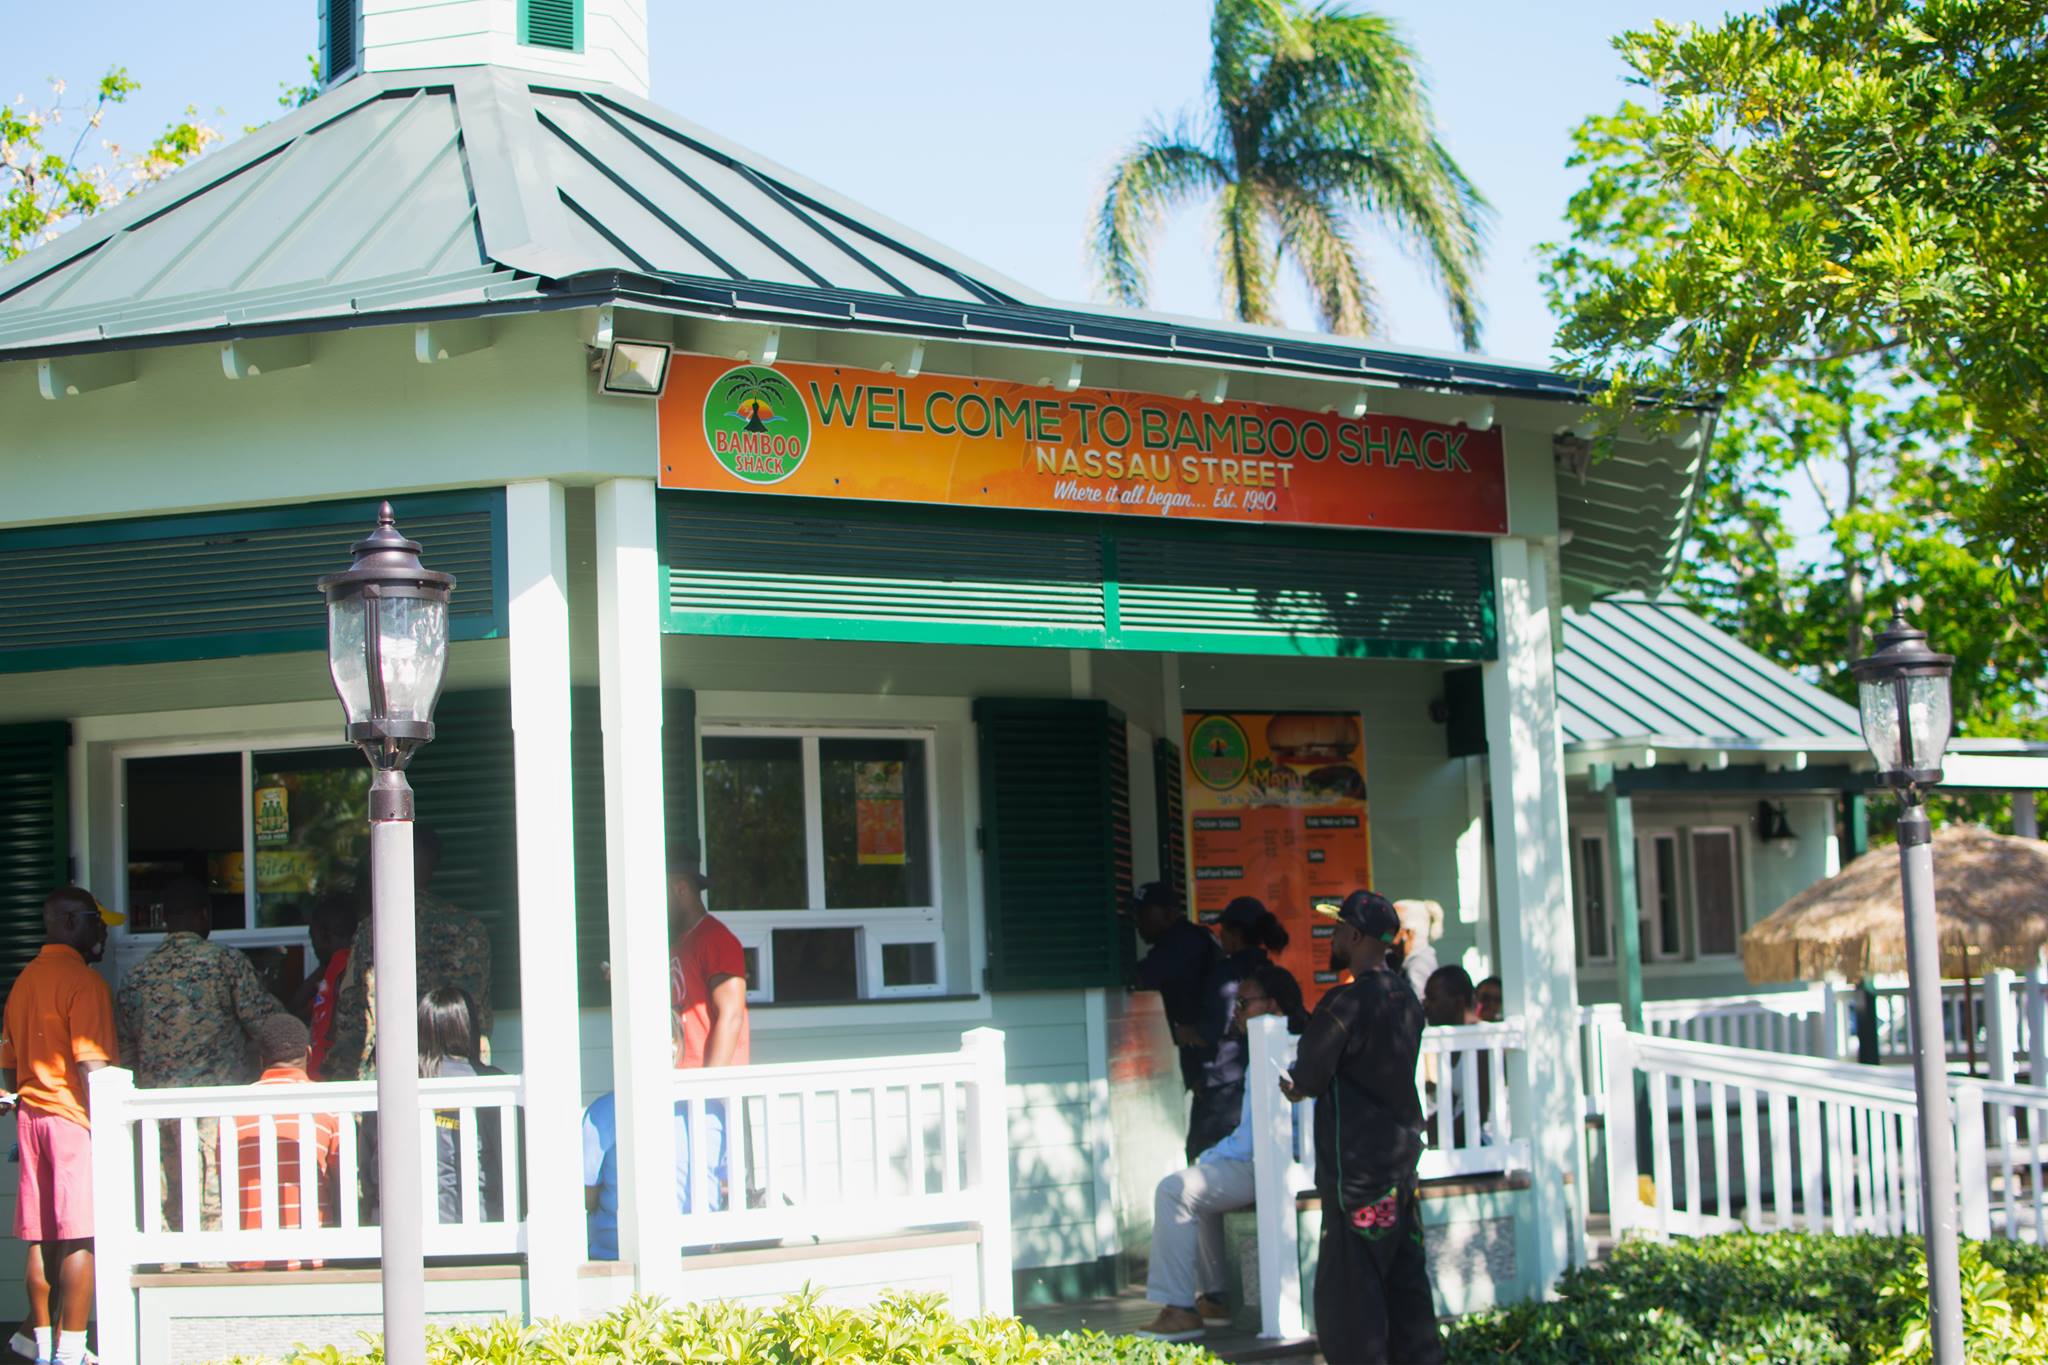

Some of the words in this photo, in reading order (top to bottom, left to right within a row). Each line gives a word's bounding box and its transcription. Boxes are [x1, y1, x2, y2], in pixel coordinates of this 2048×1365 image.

[809, 381, 1062, 443] WELCOME
[1069, 402, 1132, 448] TO
[1140, 408, 1330, 462] BAMBOO
[1337, 423, 1471, 473] SHACK
[716, 431, 801, 459] BAMBOO
[735, 456, 785, 475] SHACK
[1036, 446, 1171, 482] NASSAU
[1181, 455, 1294, 489] STREET
[1054, 480, 1101, 503] Where
[1106, 485, 1119, 502] it
[1120, 485, 1145, 505] all
[1213, 488, 1238, 508] Est.
